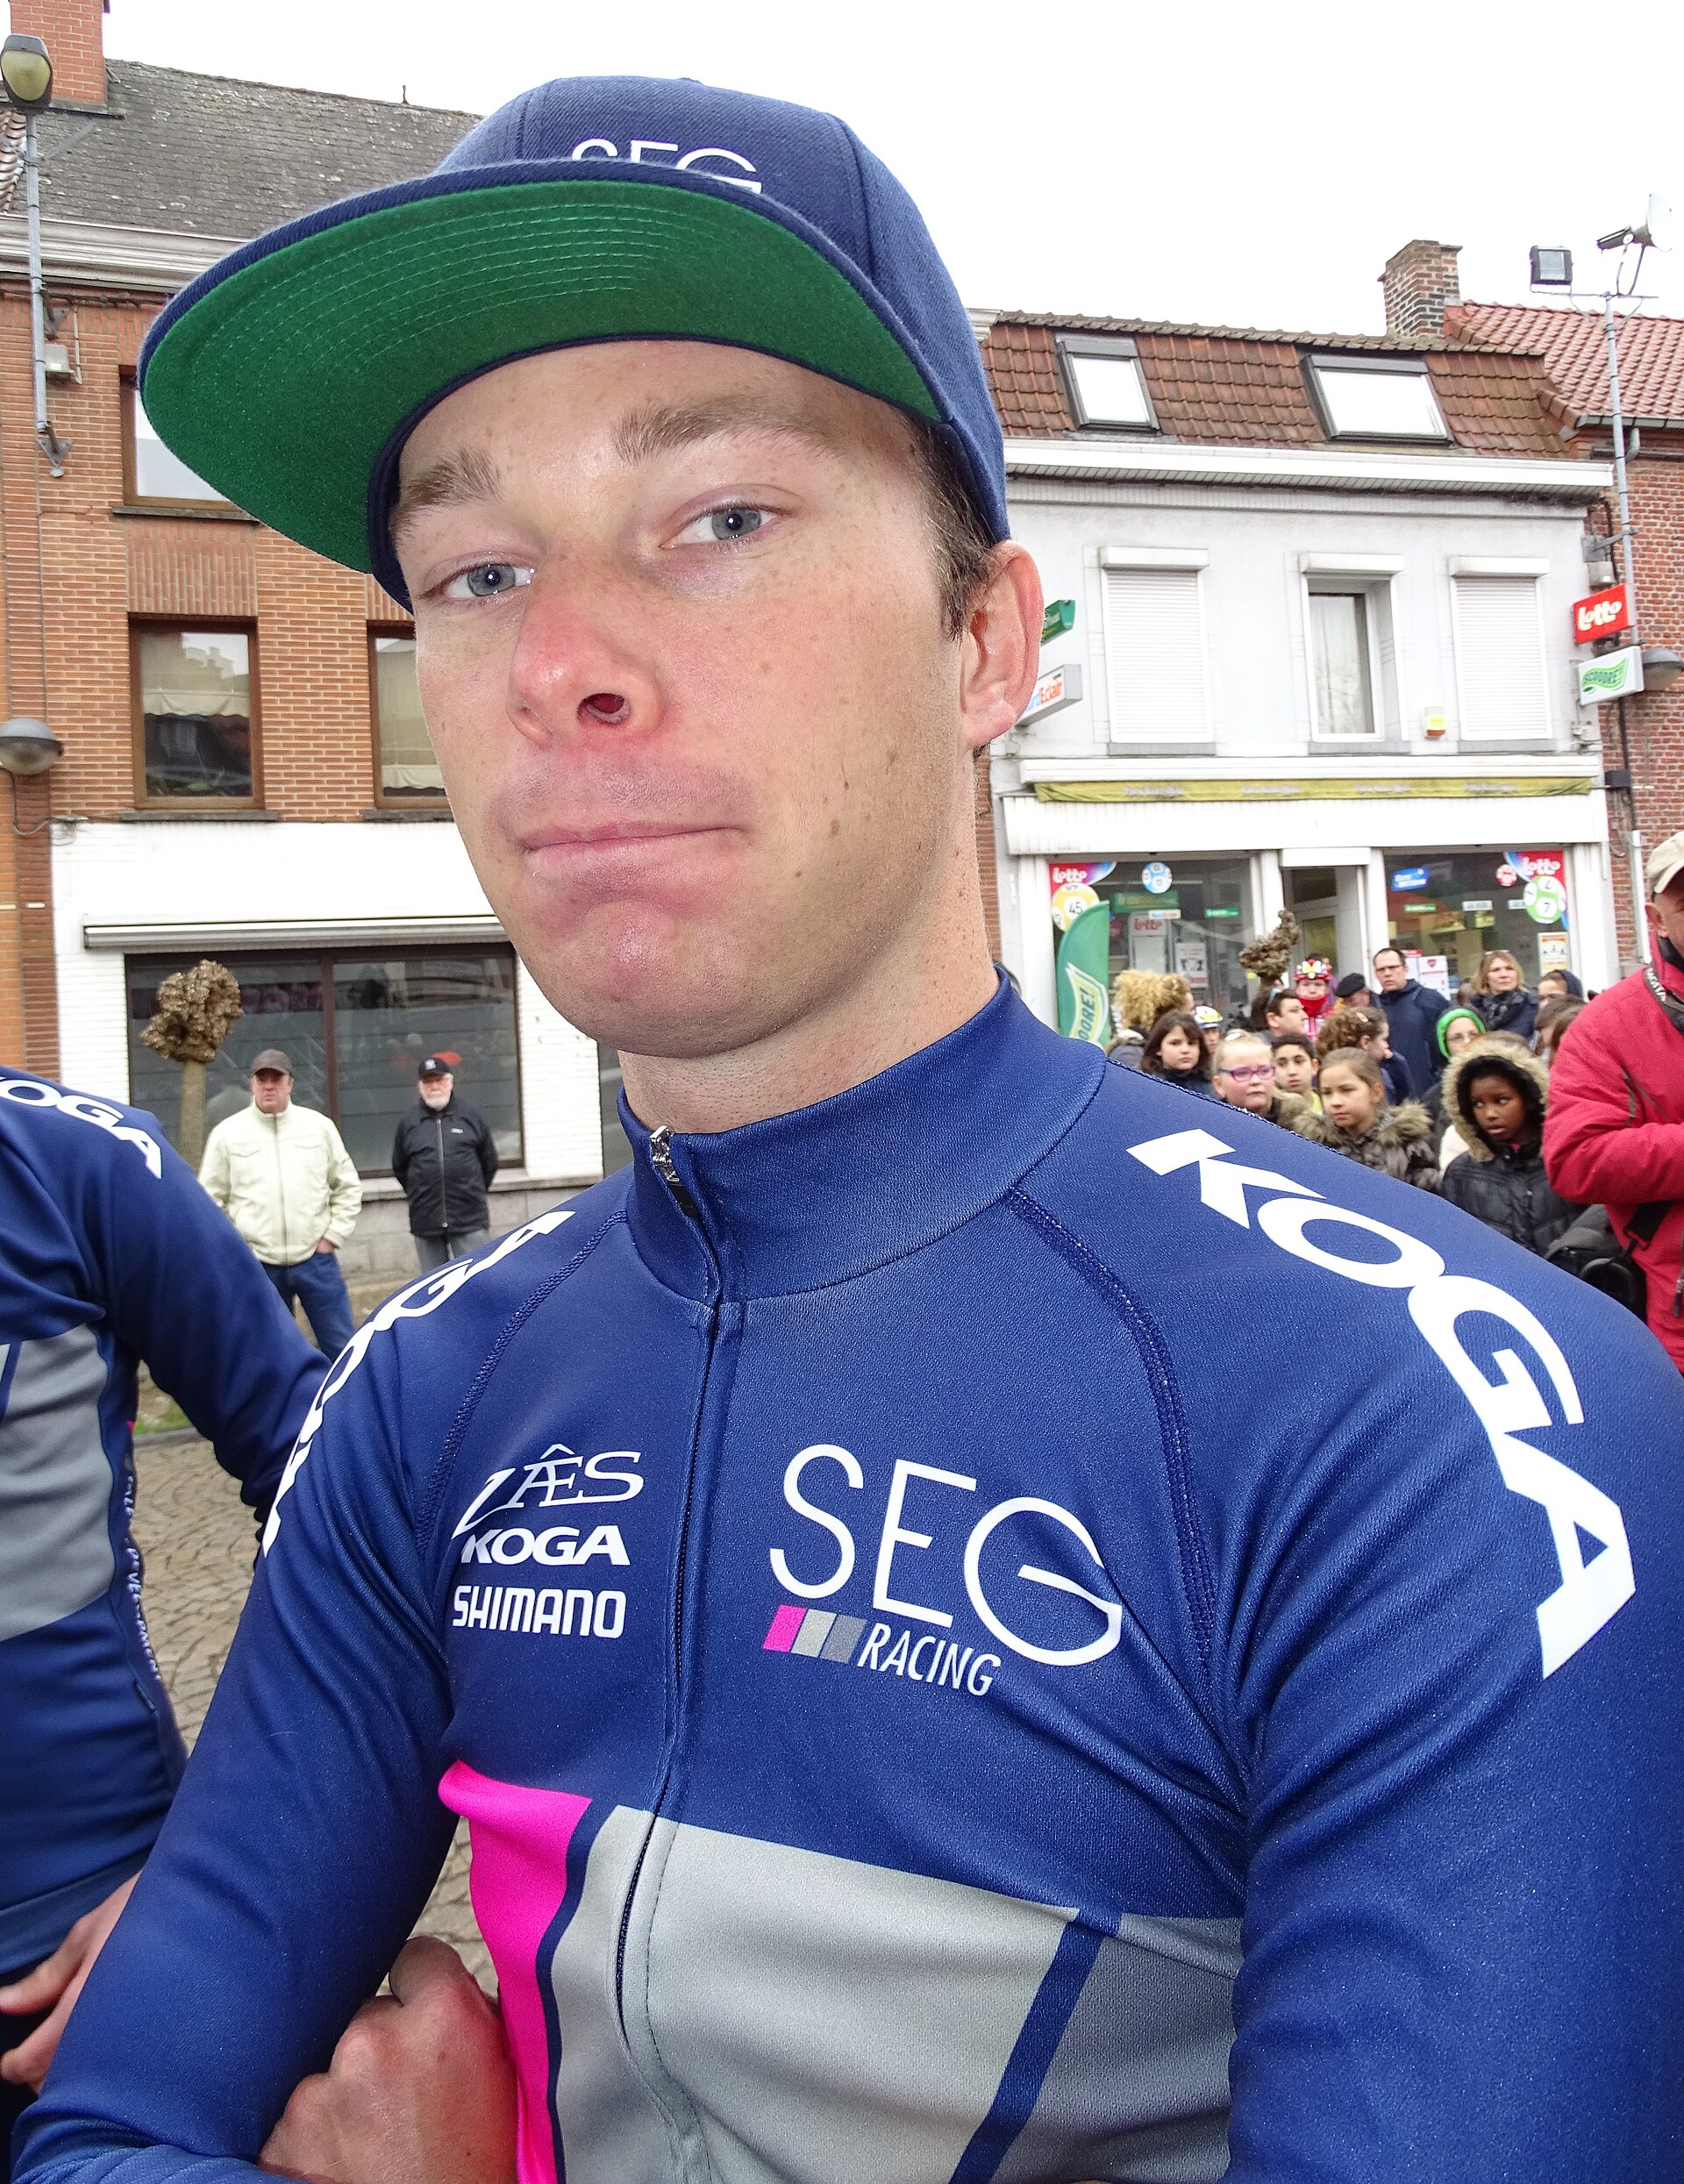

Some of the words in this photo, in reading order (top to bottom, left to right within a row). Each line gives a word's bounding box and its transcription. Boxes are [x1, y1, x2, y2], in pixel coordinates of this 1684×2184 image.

[1068, 901, 1083, 915] 45
[1077, 986, 1095, 1041] OORE!
[0, 1076, 162, 1180] OGA
[1125, 1128, 1637, 1680] KOGA
[460, 1524, 631, 1567] KOGA
[769, 1444, 1124, 1667] SEG
[452, 1584, 627, 1639] SHIMANO
[857, 1622, 1002, 1696] RACING
